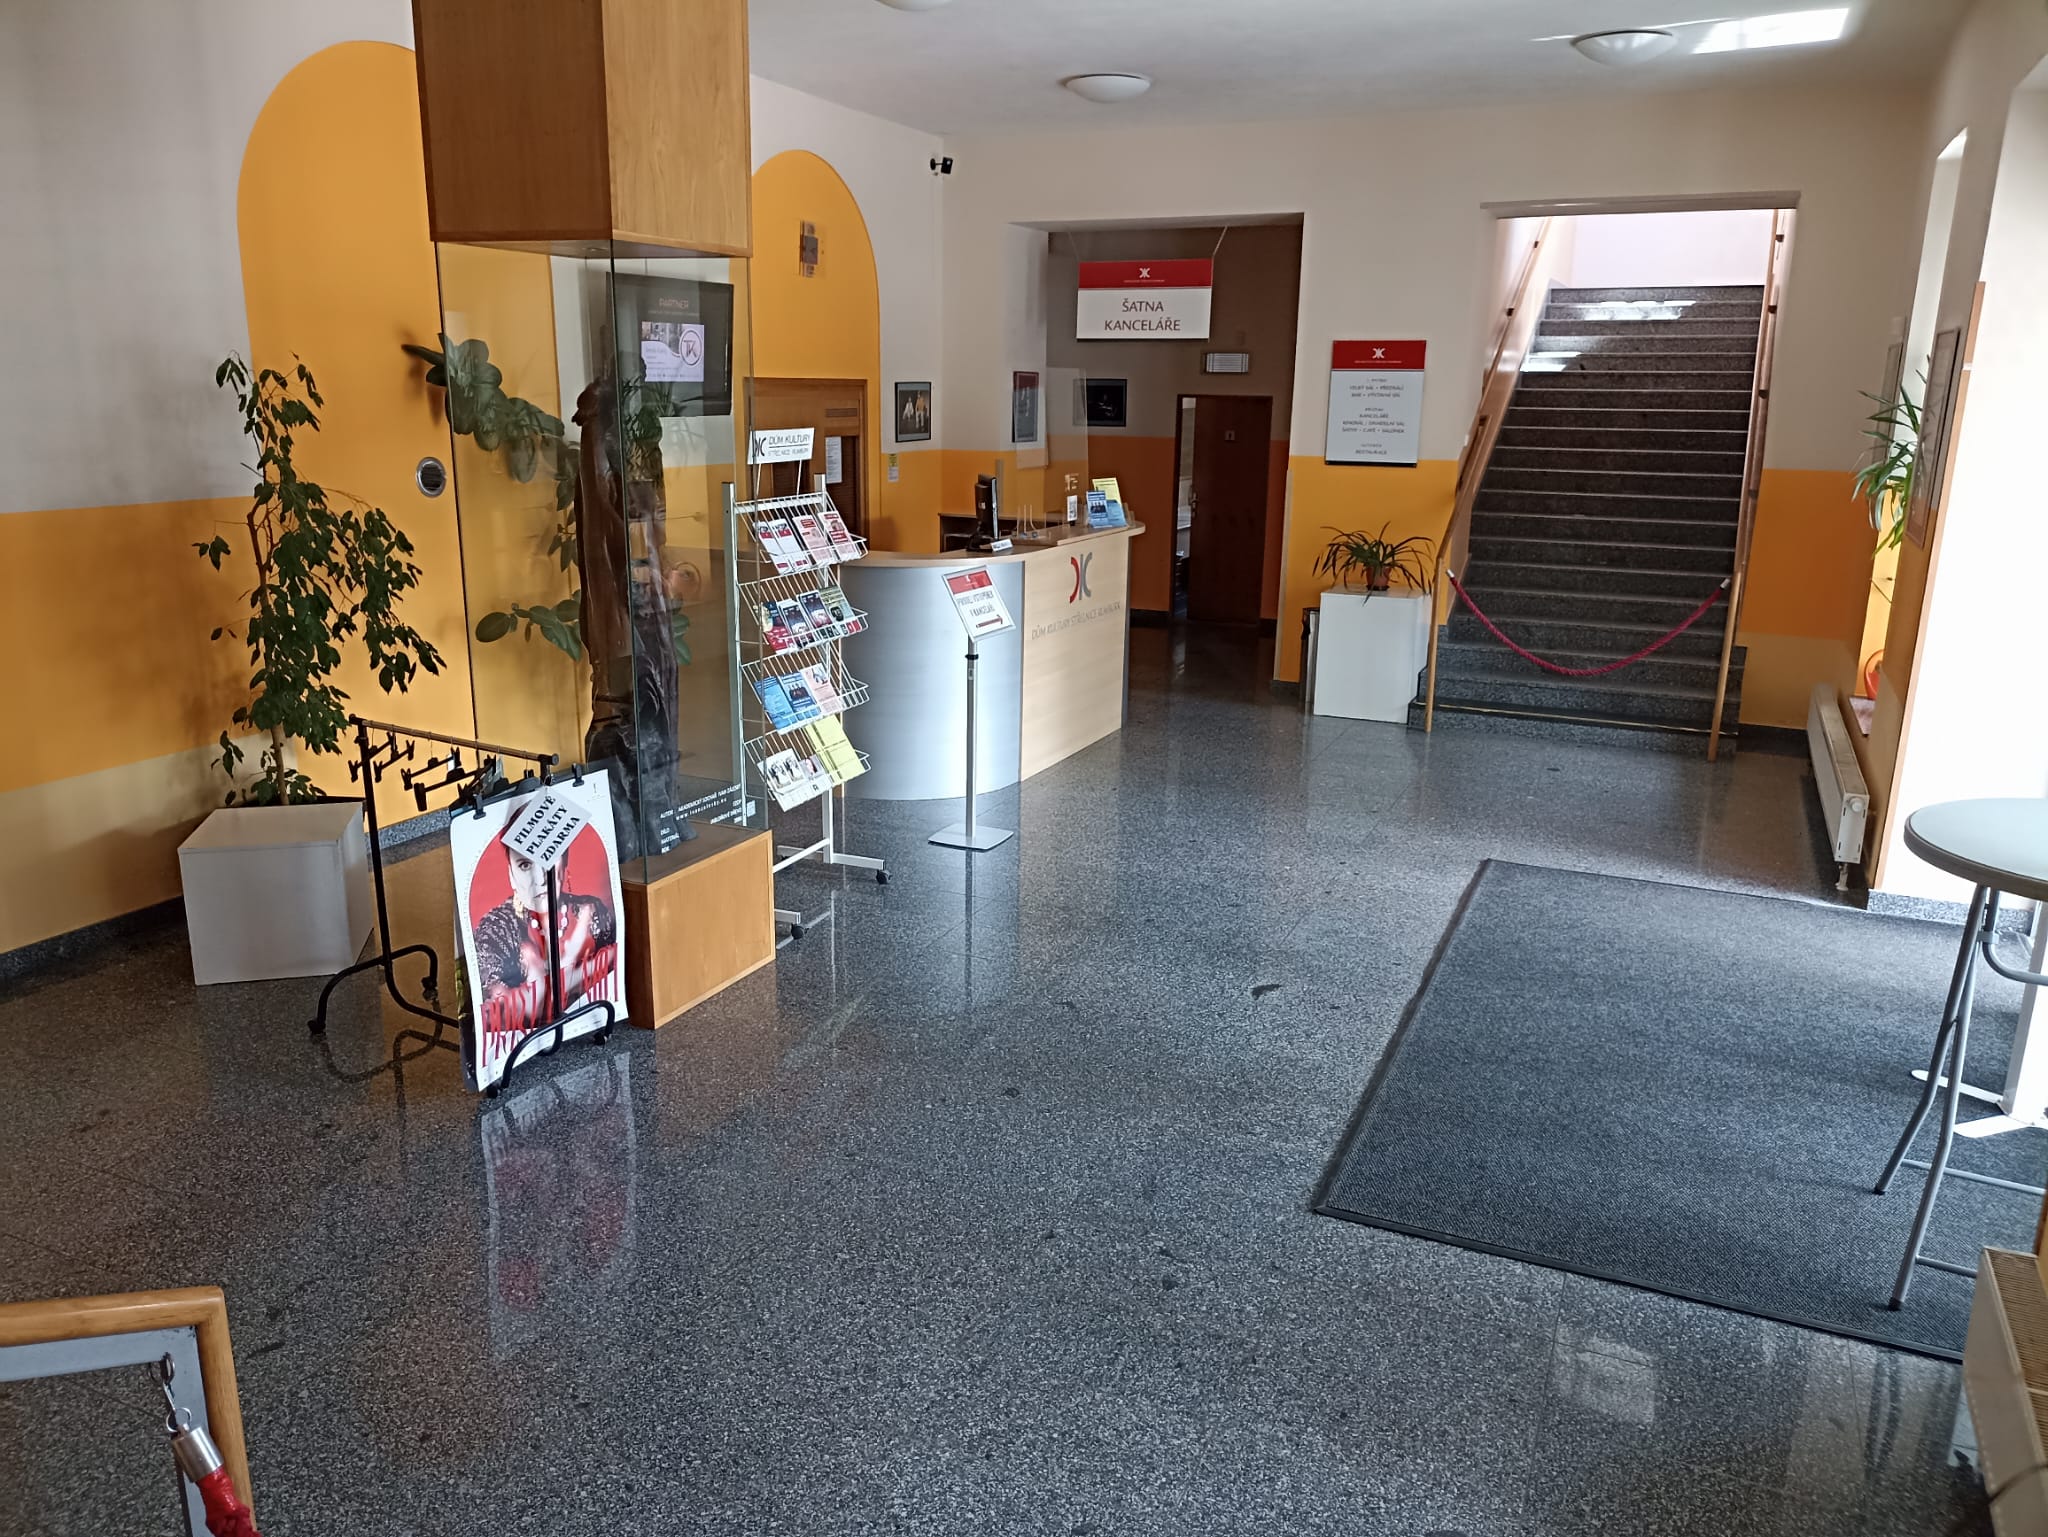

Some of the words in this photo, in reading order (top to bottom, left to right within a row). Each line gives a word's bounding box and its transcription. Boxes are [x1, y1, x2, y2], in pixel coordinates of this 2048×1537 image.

[1122, 298, 1164, 313] ŠATNA
[1104, 317, 1181, 332] KANCELÁŘE
[768, 434, 784, 445] DŮM
[784, 434, 810, 445] KULTURY
[514, 795, 556, 845] FILMOVÉ
[526, 805, 568, 855] PLAKÁTY
[541, 816, 580, 861] ZDARMA
